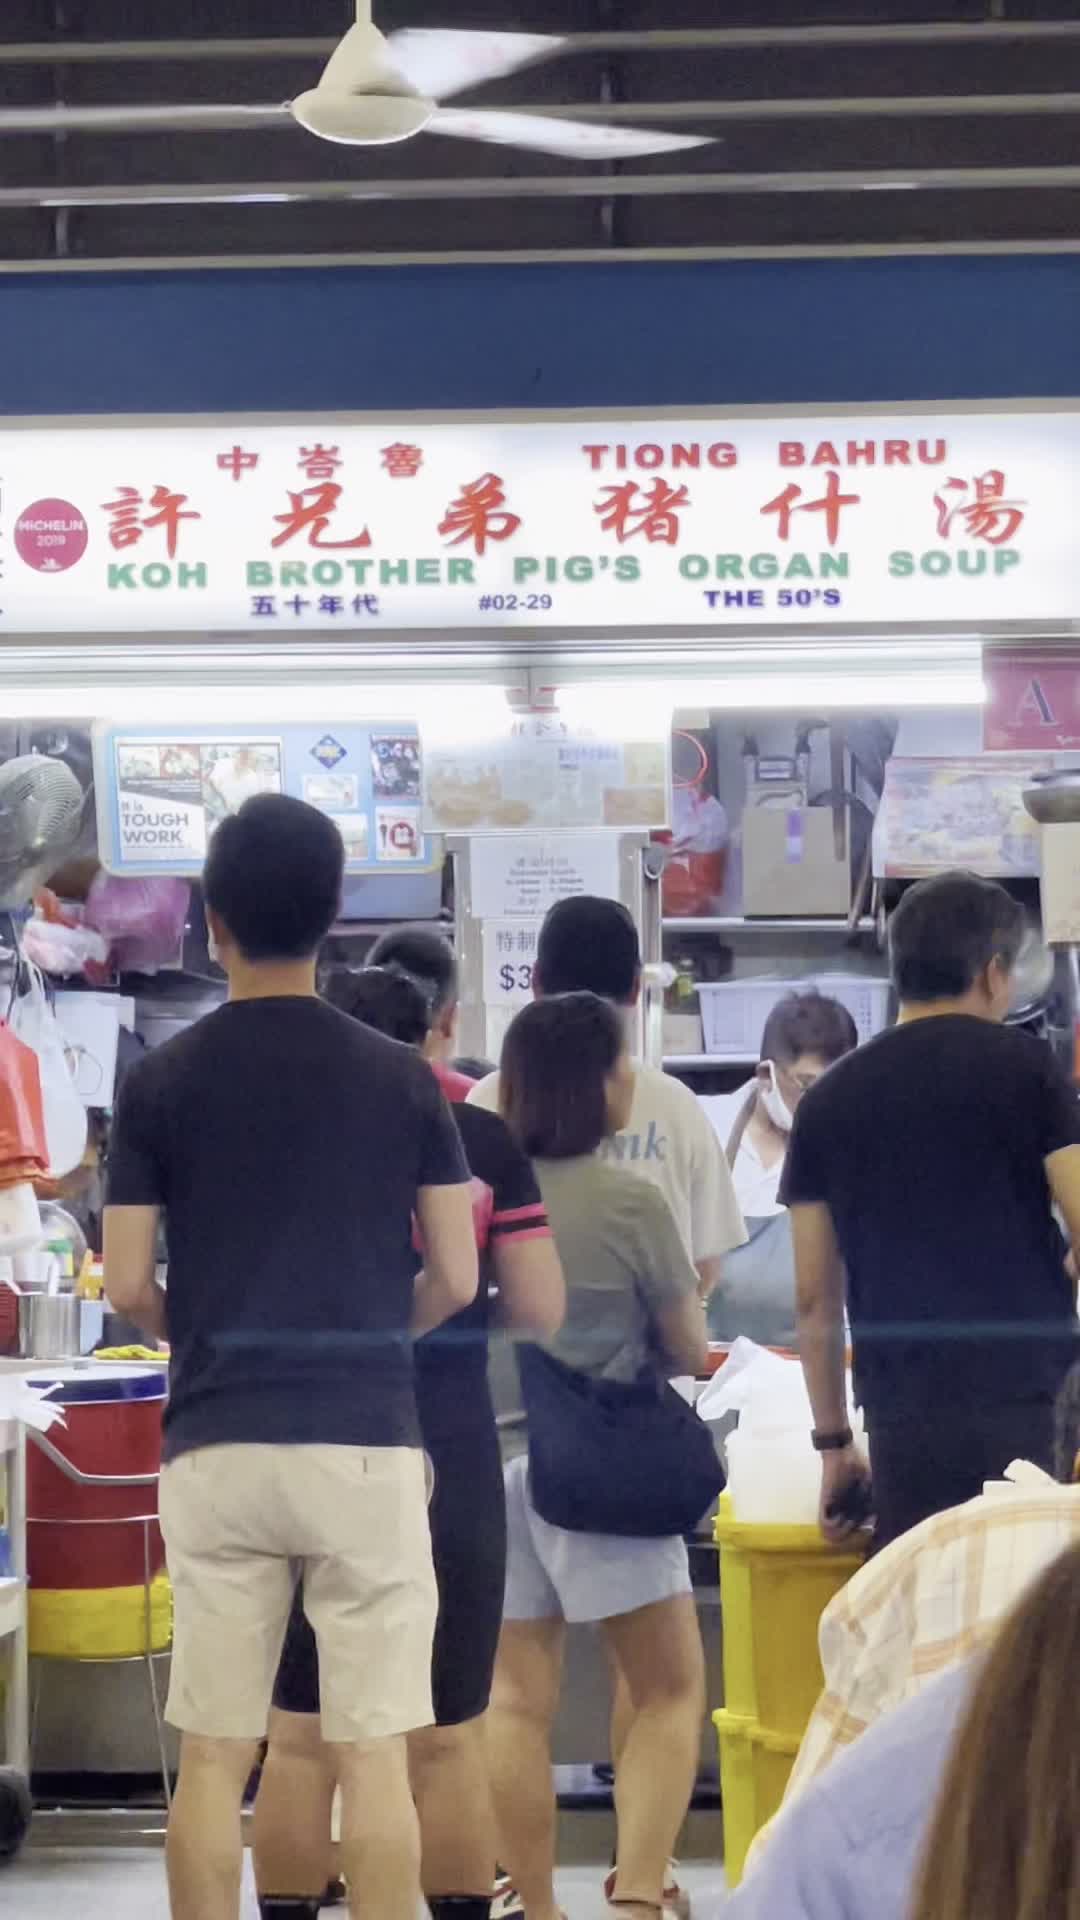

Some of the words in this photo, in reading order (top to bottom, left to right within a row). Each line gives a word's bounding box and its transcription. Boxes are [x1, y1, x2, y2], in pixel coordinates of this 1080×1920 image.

[582, 442, 738, 470] TIONG
[778, 438, 947, 467] BAHRU
[19, 519, 84, 532] MICHELIN
[36, 534, 66, 547] 2019
[107, 563, 208, 589] KOH
[246, 558, 476, 587] BROTHER
[514, 556, 641, 583] PIG'S
[679, 553, 850, 580] ORGAN
[889, 549, 1021, 577] SOUP
[250, 594, 380, 617] 五十年代
[478, 593, 553, 611] #02-29
[704, 590, 764, 608] THE
[777, 589, 842, 607] 50'S
[122, 813, 189, 827] TOUGH
[123, 830, 183, 843] WORK
